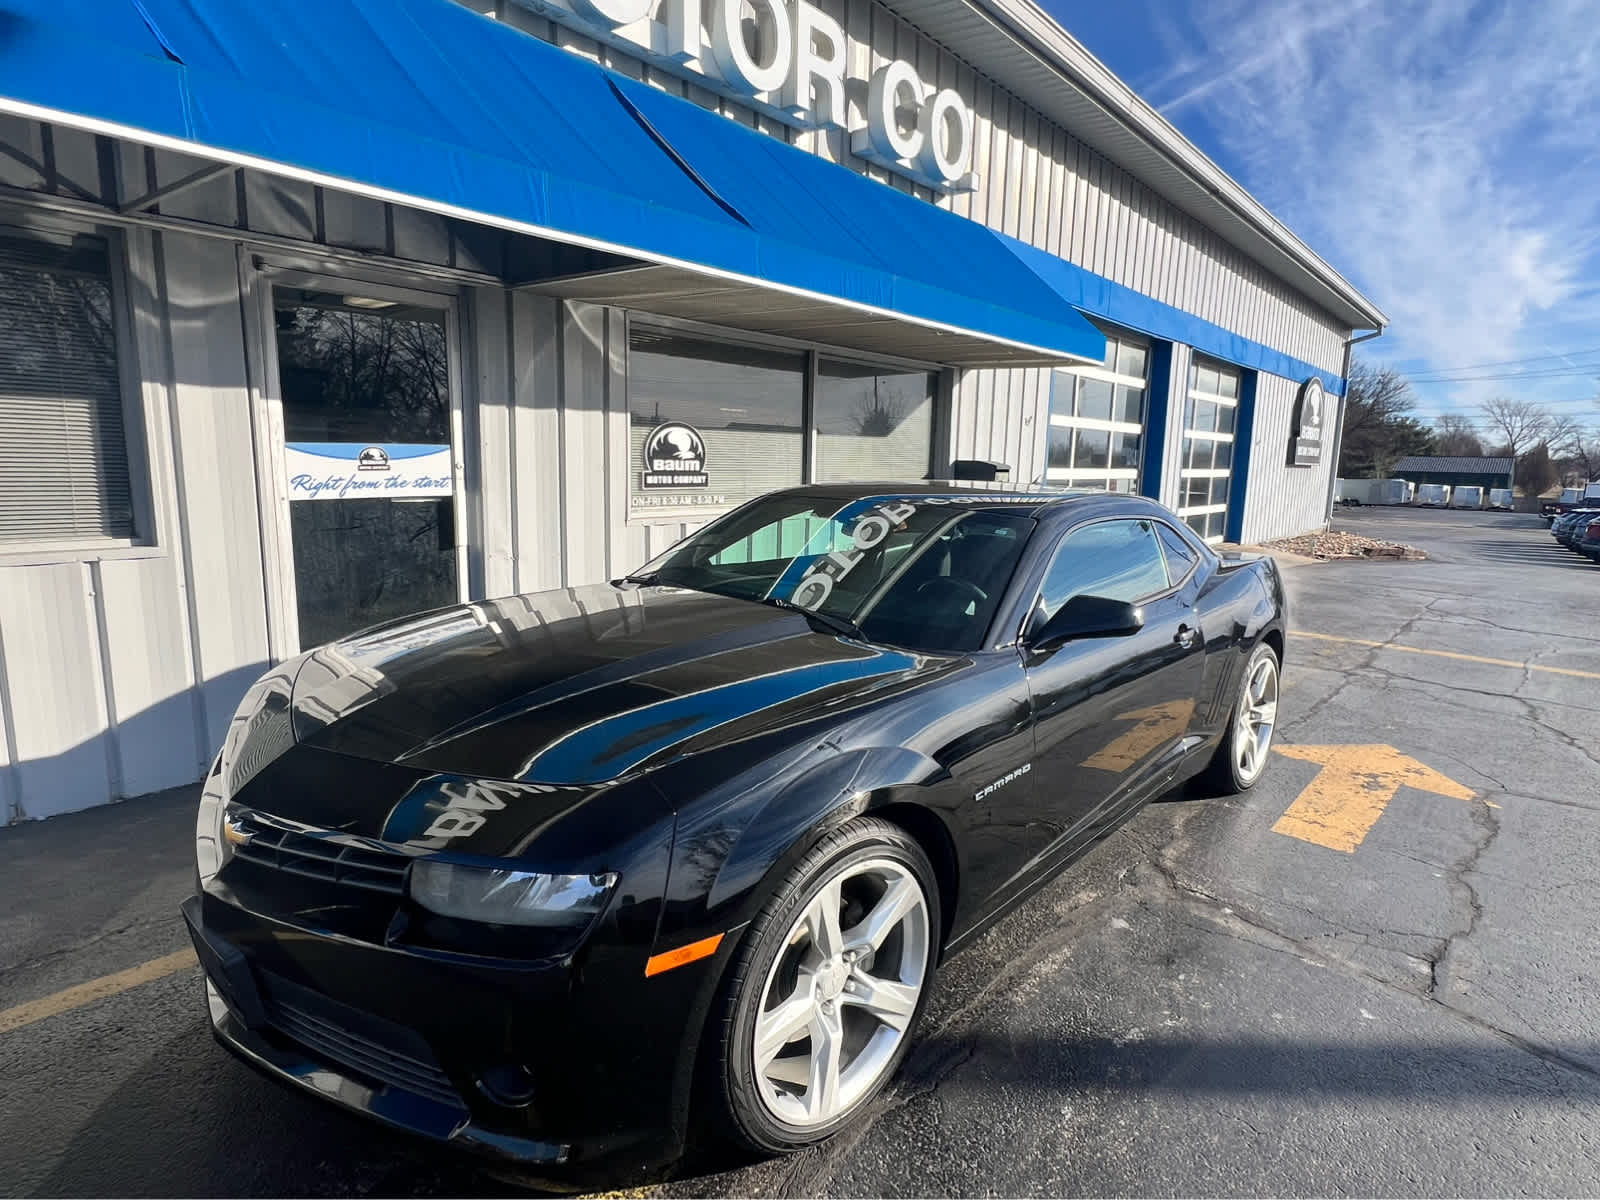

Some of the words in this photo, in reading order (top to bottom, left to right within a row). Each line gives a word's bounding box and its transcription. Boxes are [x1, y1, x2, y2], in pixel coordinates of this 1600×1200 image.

[870, 59, 970, 182] CO
[653, 459, 700, 471] Baum
[290, 473, 344, 498] Right
[339, 474, 383, 497] from
[382, 475, 409, 488] the
[646, 475, 672, 484] MOTOR
[673, 475, 707, 484] COMPANY
[975, 763, 1031, 801] CAMARO
